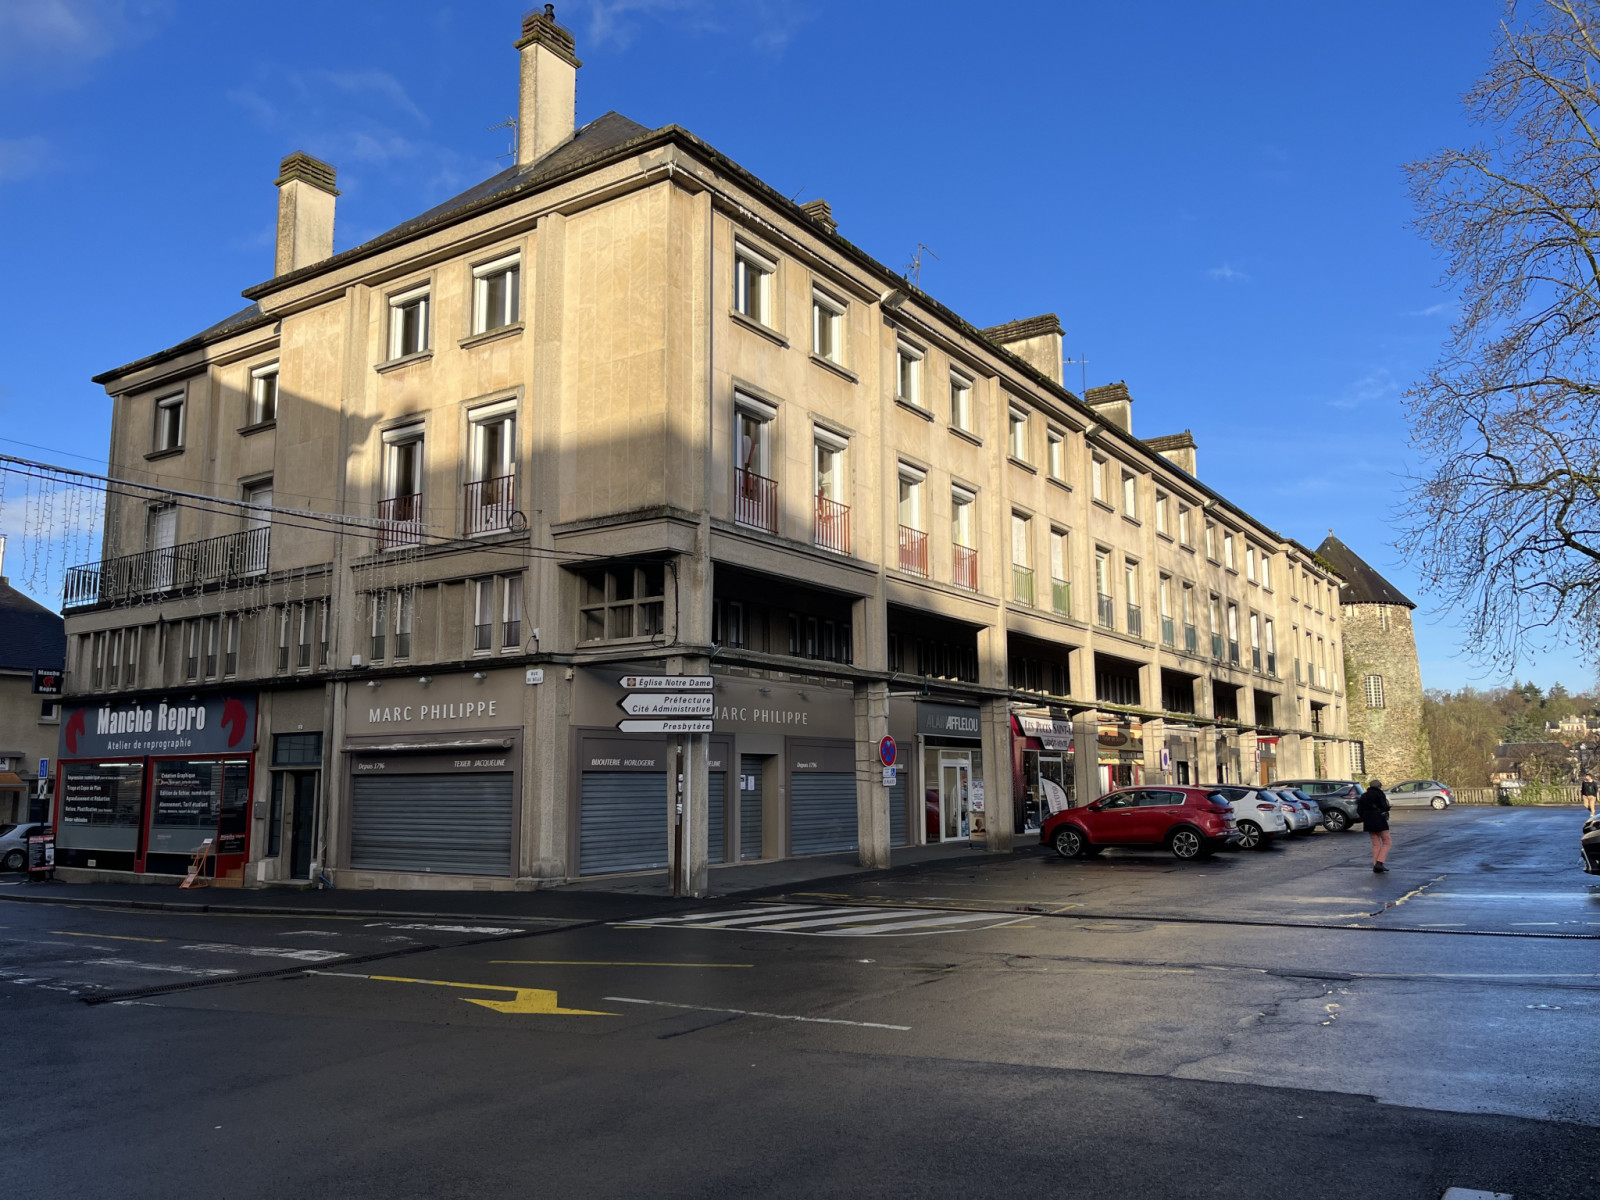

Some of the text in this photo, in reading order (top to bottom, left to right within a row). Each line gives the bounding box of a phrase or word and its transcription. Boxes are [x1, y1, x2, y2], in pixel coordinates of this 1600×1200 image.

[638, 677, 662, 688] Église
[664, 678, 686, 686] Notre
[369, 700, 496, 722] MARC PHILIPPE
[754, 708, 808, 725] PHILIPPE
[97, 703, 206, 735] Manche Repro
[946, 716, 978, 732] AFFLELOU
[662, 722, 710, 731] Presbytère
[1053, 723, 1074, 736] SAINT-L
[107, 738, 192, 751] Atelier de reprographie
[474, 759, 506, 767] JACQUELINE
